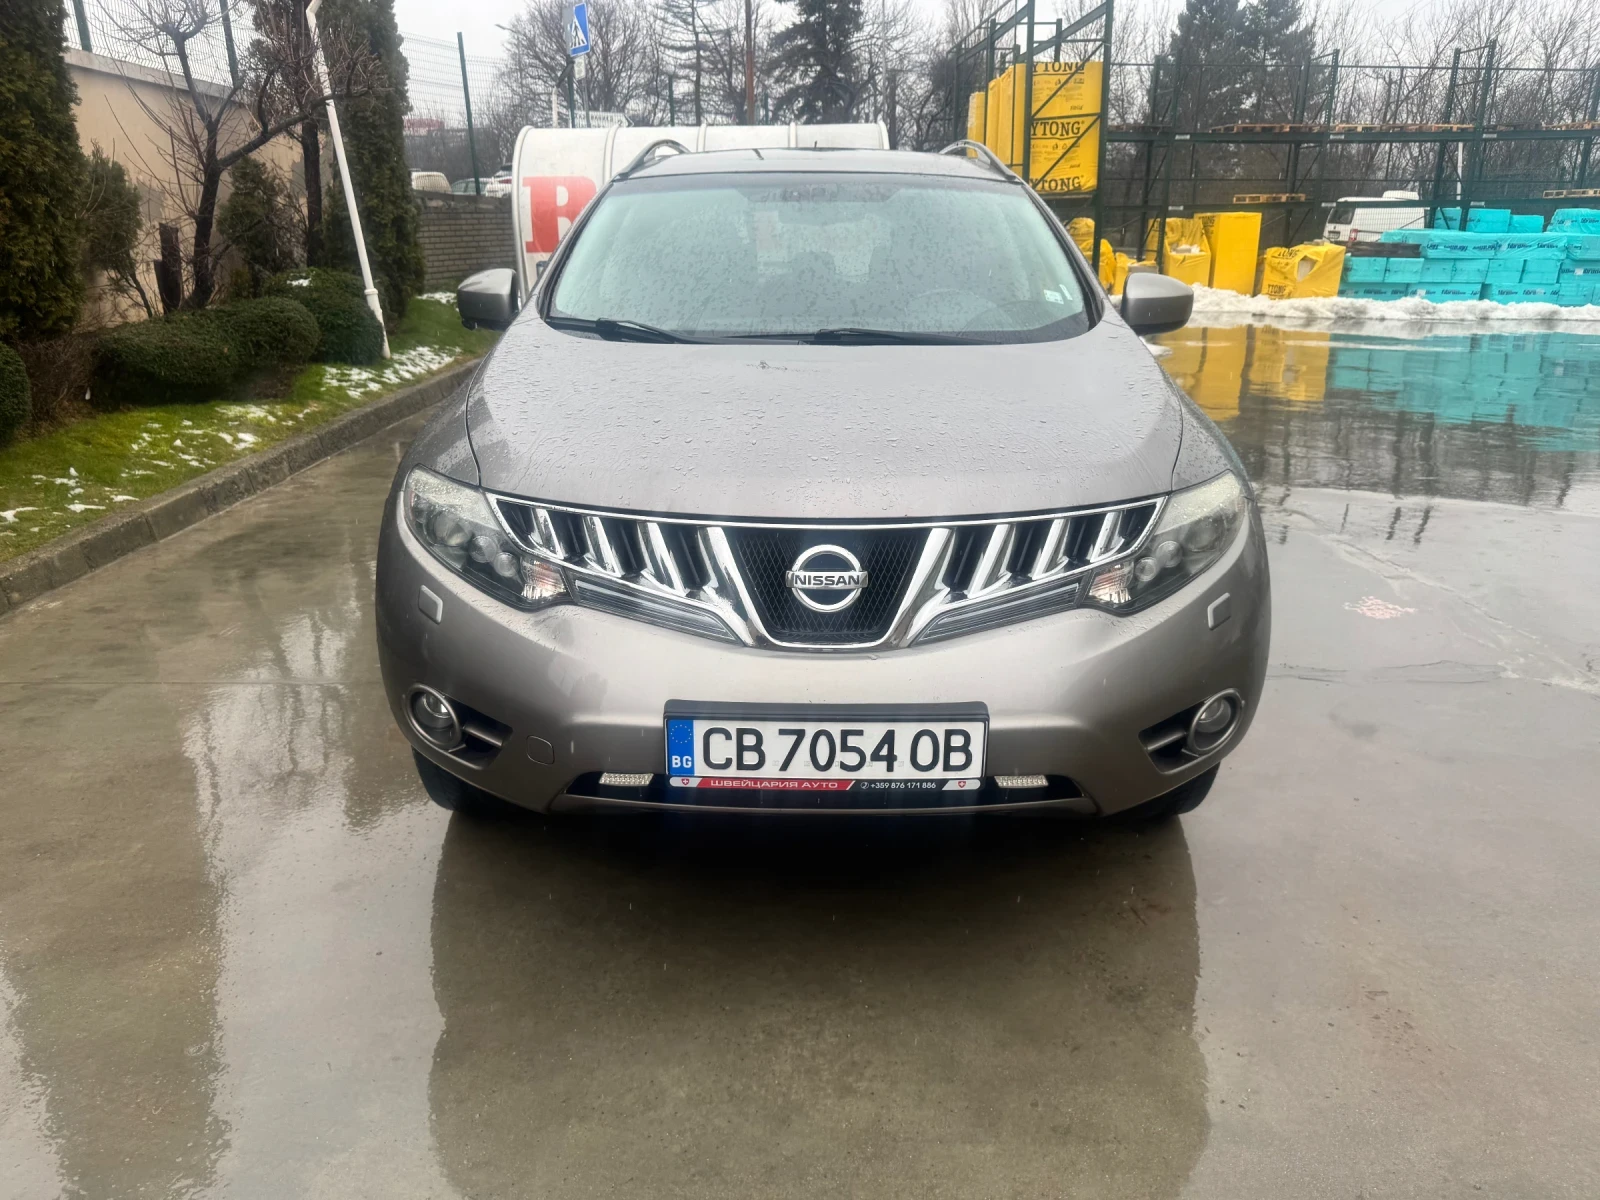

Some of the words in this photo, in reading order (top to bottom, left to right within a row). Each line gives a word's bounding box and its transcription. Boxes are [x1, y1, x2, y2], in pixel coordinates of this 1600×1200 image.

[794, 574, 860, 586] NISSAN
[671, 755, 693, 769] BG
[710, 779, 798, 789] ШВЕЙЦАРИЯ
[801, 781, 838, 789] АУТО
[891, 782, 905, 790] 876
[922, 782, 937, 790] 886
